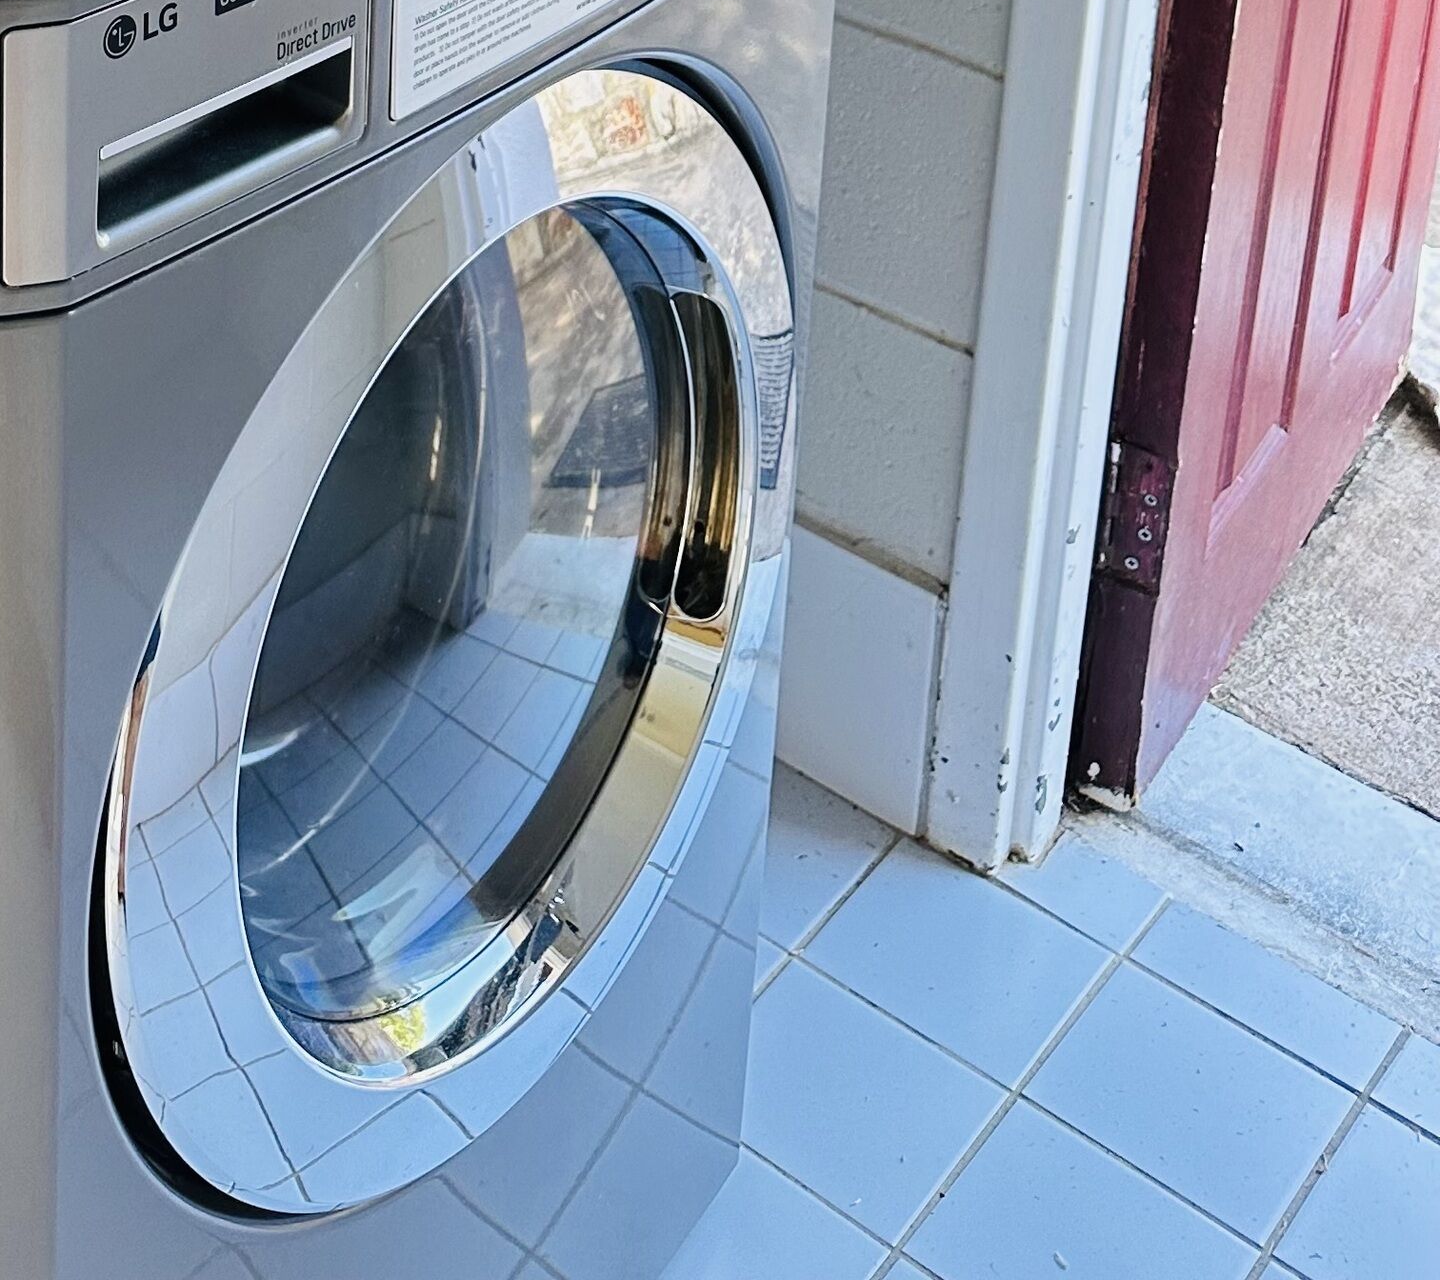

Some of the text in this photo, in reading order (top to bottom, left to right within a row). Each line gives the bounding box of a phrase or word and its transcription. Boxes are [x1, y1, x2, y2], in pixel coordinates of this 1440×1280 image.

[143, 2, 178, 40] LG
[277, 14, 356, 61] Direct Drive
